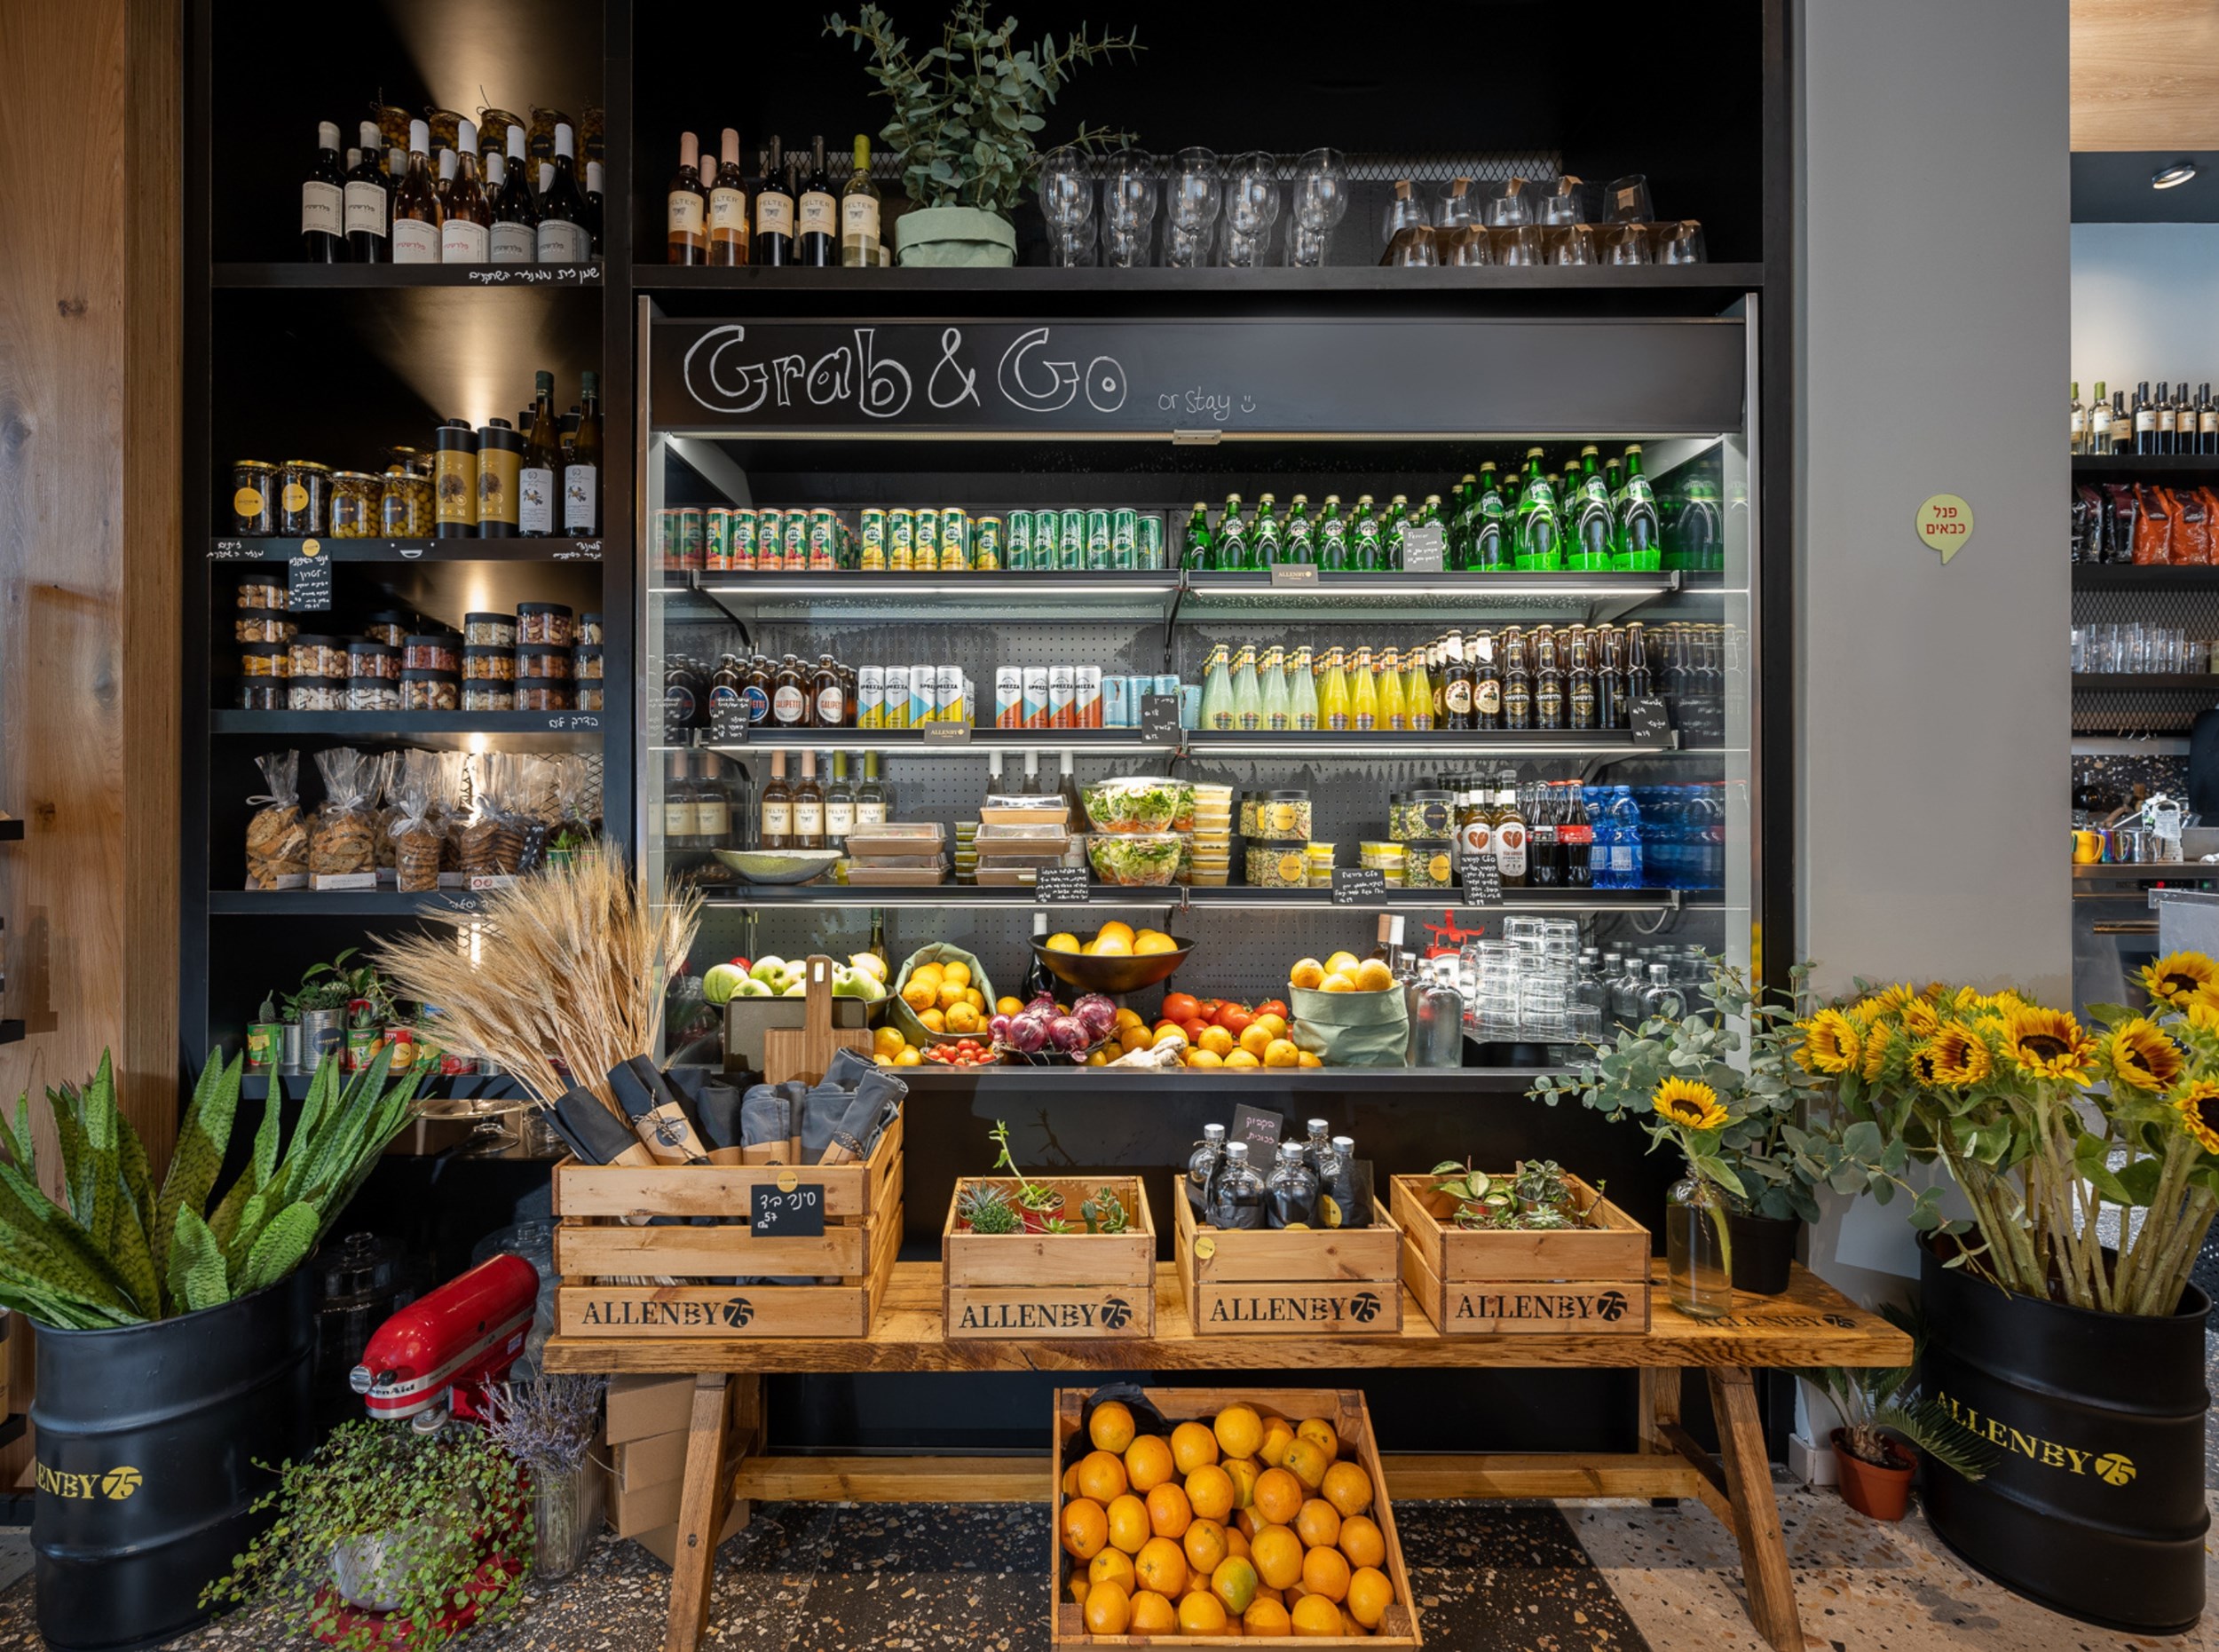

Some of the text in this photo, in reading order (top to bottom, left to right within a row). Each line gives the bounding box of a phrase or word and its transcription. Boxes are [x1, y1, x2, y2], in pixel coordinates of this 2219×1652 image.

[579, 267, 600, 284] שמן
[683, 325, 1230, 421] Grab & Go or stay
[1933, 505, 1957, 518] פנל
[1926, 523, 1966, 534] כבאים
[821, 700, 842, 708] GALIPET
[1245, 1116, 1275, 1129] בקבוק
[1246, 1131, 1275, 1144] זכוכית
[760, 1191, 816, 1211] סינר בד
[764, 1212, 778, 1221] 57
[581, 1300, 721, 1326] ALLENBY
[959, 1303, 1099, 1329] ALLENBY
[1209, 1297, 1348, 1323] ALLENBY
[1455, 1294, 1595, 1320] ALLENBY
[1936, 1390, 2094, 1476] ALLENBY
[36, 1462, 101, 1499] ENBY
